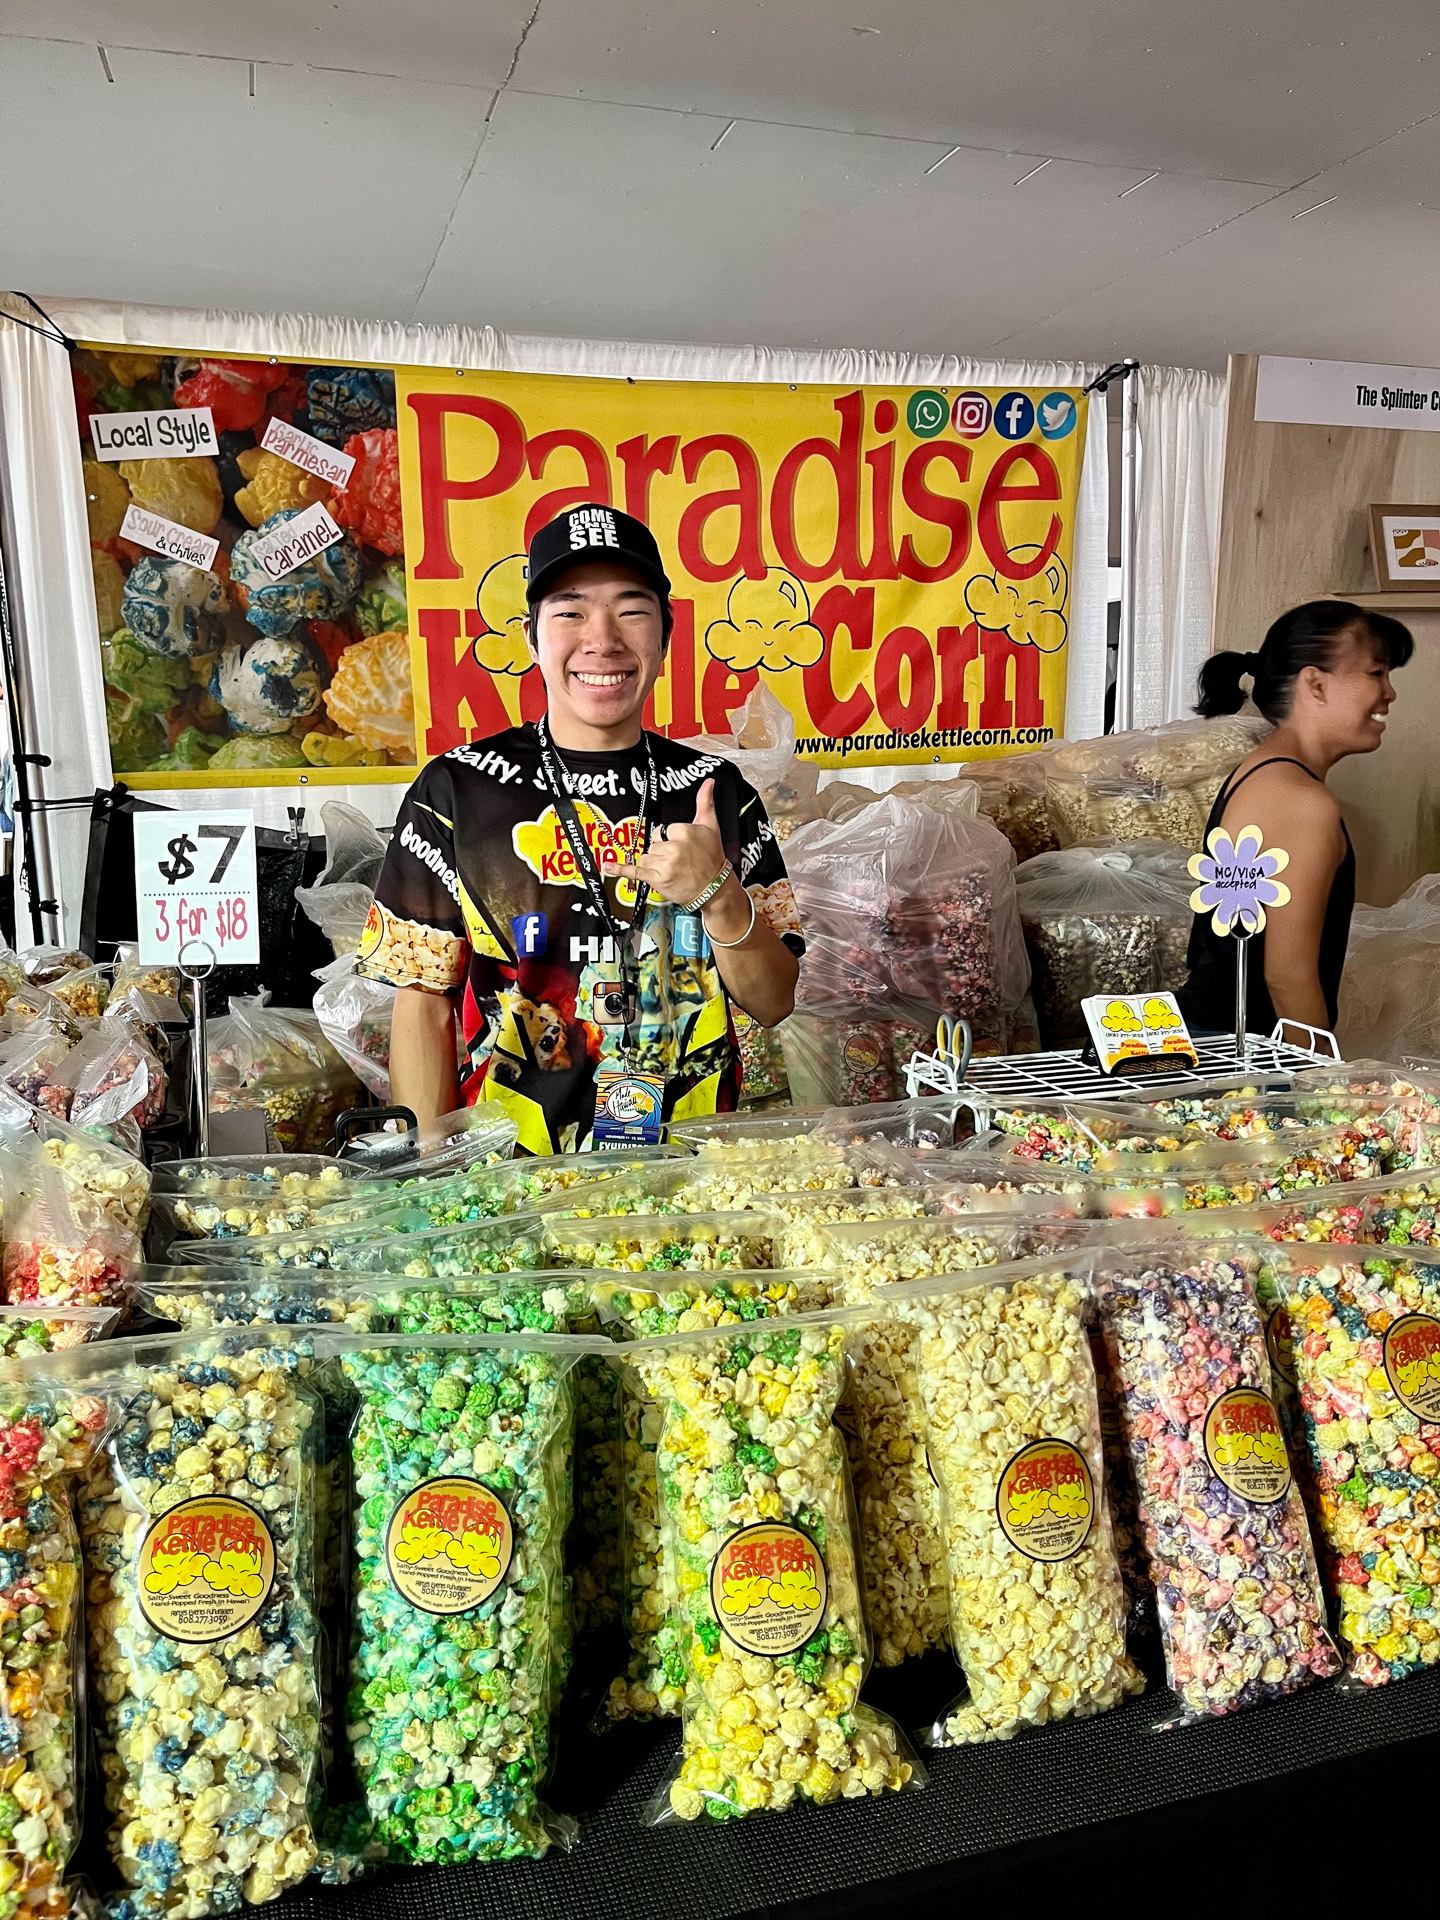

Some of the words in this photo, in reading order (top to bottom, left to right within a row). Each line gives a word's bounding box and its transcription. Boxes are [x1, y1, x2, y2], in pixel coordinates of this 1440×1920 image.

[1357, 385, 1378, 406] The
[1381, 387, 1428, 411] Splinter
[94, 417, 153, 448] Local
[156, 414, 211, 453] Style
[406, 390, 1063, 582] Paradise
[127, 508, 166, 538] Sour
[569, 509, 615, 528] COME
[569, 522, 616, 533] AND
[156, 536, 166, 550] &
[569, 528, 620, 551] SEE
[805, 585, 1045, 736] Corn
[444, 745, 523, 784] Salty.
[158, 824, 246, 885] $7
[1215, 865, 1265, 881] MC/VISA
[1215, 880, 1257, 891] accepted
[155, 900, 170, 943] 3
[176, 899, 208, 946] for
[215, 898, 248, 947] $18
[1015, 1453, 1076, 1475] Paradise
[1007, 1472, 1053, 1498] Kettle
[1055, 1467, 1085, 1485] Corn
[417, 1491, 497, 1520] Paradise
[168, 1514, 255, 1537] Paradise
[403, 1509, 459, 1532] Kettle
[462, 1513, 505, 1541] Corn
[152, 1532, 216, 1557] Kettle
[219, 1533, 265, 1557] Corn
[730, 1538, 804, 1562] Paradise
[396, 1562, 434, 1573] Salty-Sweet
[436, 1567, 468, 1576] Goodness
[399, 1570, 439, 1579] Hand-Popped
[722, 1558, 774, 1583] Kettle
[777, 1553, 816, 1573] Corn
[421, 1587, 466, 1600] 808.277.3059
[178, 1615, 228, 1625] 808.277.3059
[726, 1614, 763, 1622] Salty-Sweet
[765, 1610, 796, 1618] Goodness
[730, 1618, 769, 1627] Hand-Popped
[756, 1629, 799, 1641] 808.277.3059
